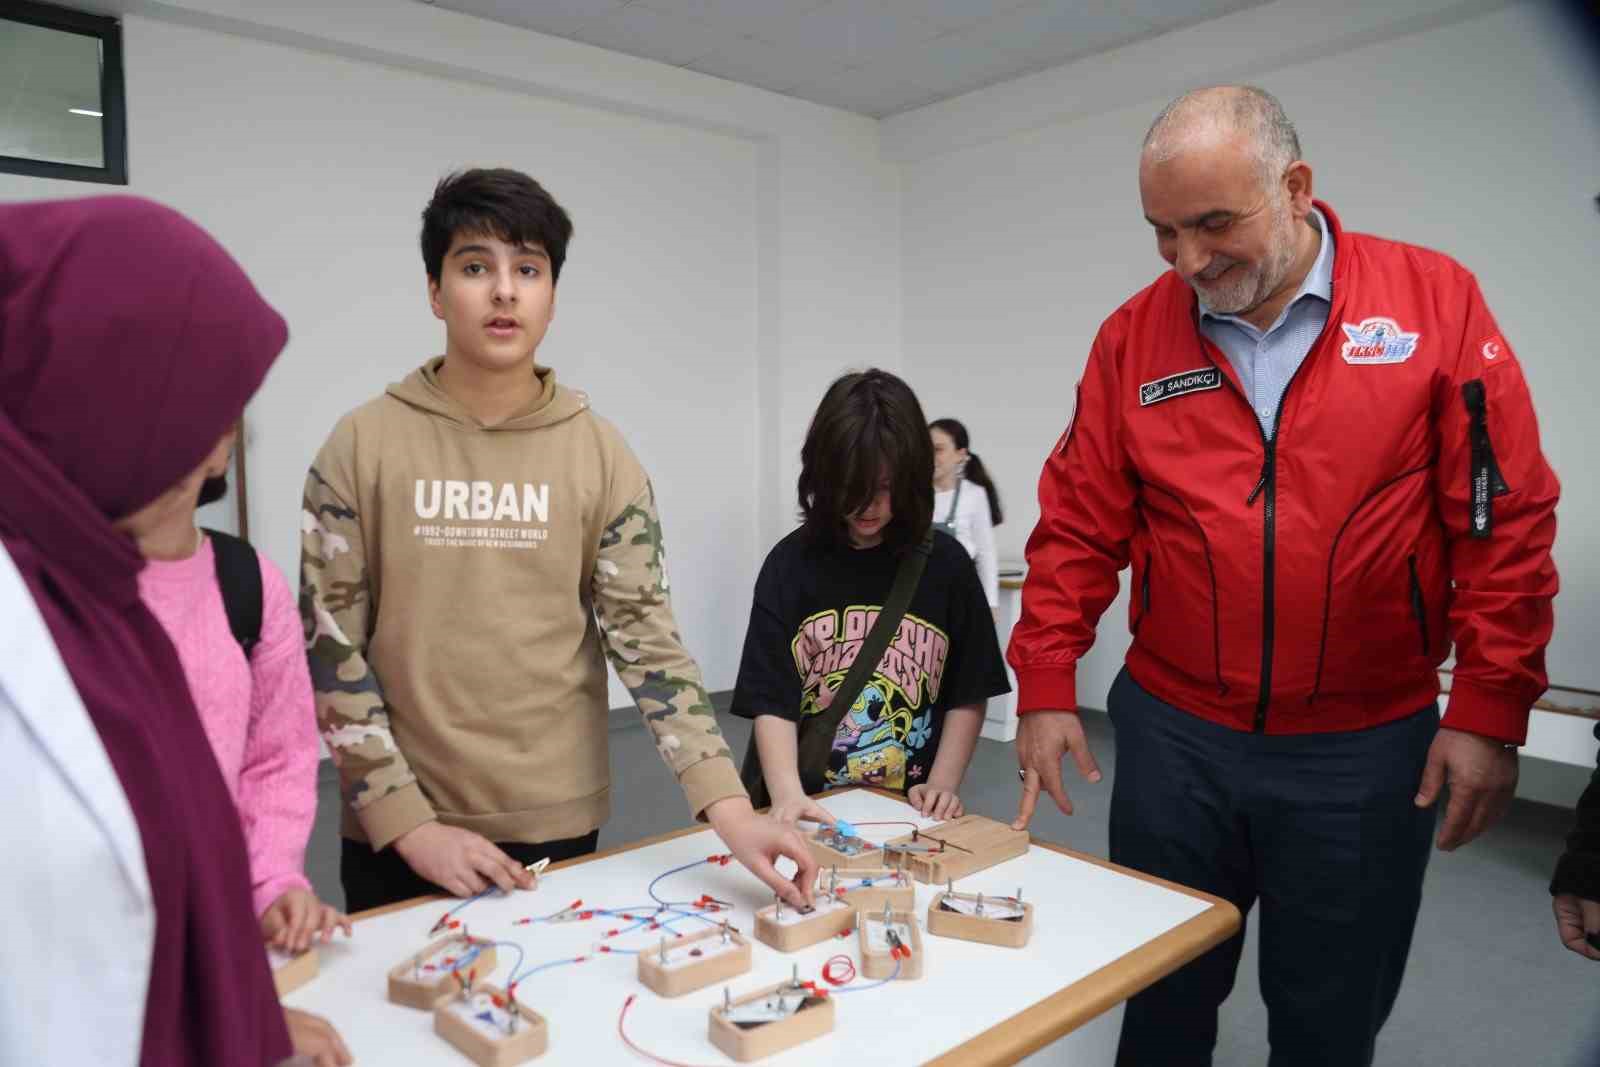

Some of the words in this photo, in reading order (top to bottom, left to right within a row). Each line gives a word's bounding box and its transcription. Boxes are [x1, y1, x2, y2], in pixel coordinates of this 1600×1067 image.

[1167, 371, 1215, 392] SANDIKÇI
[415, 479, 549, 523] URBAN
[489, 527, 520, 539] STREET
[521, 529, 549, 541] WORLD
